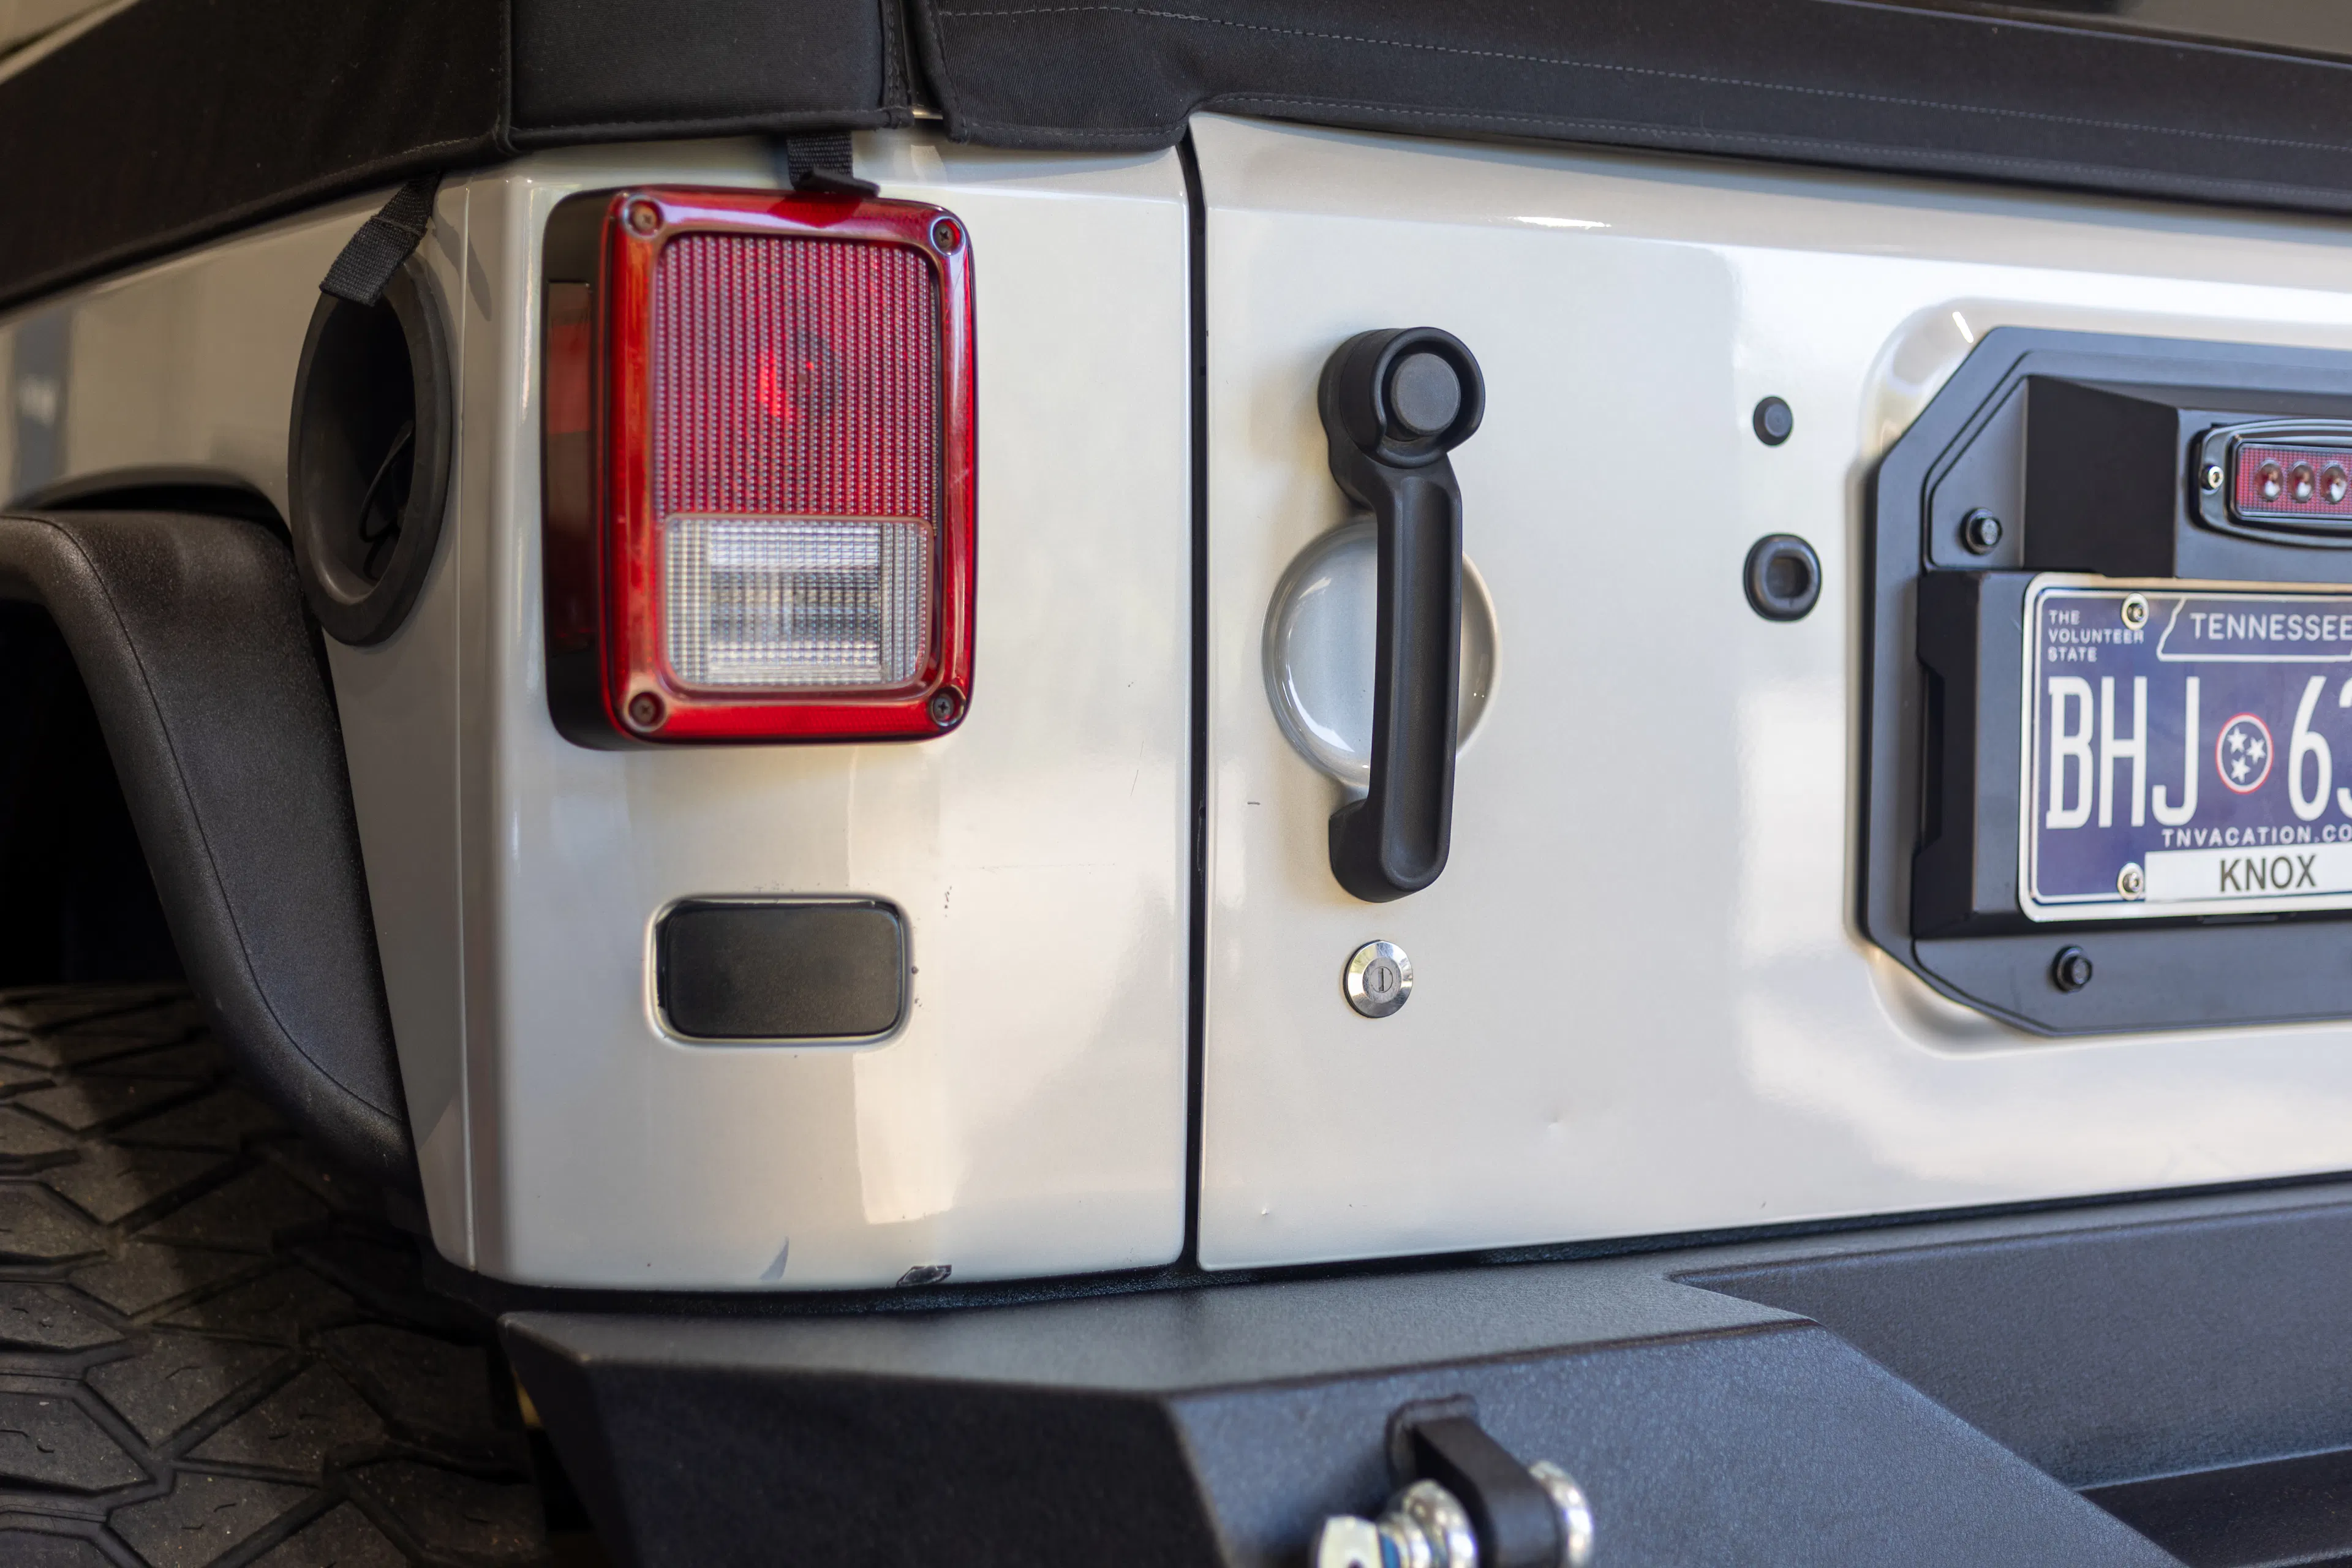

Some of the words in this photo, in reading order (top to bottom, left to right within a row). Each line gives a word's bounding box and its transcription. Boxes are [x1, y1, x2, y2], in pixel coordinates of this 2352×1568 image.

[2049, 609, 2081, 625] THE
[2190, 613, 2352, 641] TENNESSEE
[2048, 628, 2144, 644] VOLUNTEER
[2048, 646, 2097, 662] STATE
[2046, 676, 2200, 829] BHJ
[2220, 854, 2317, 892] KNOX
